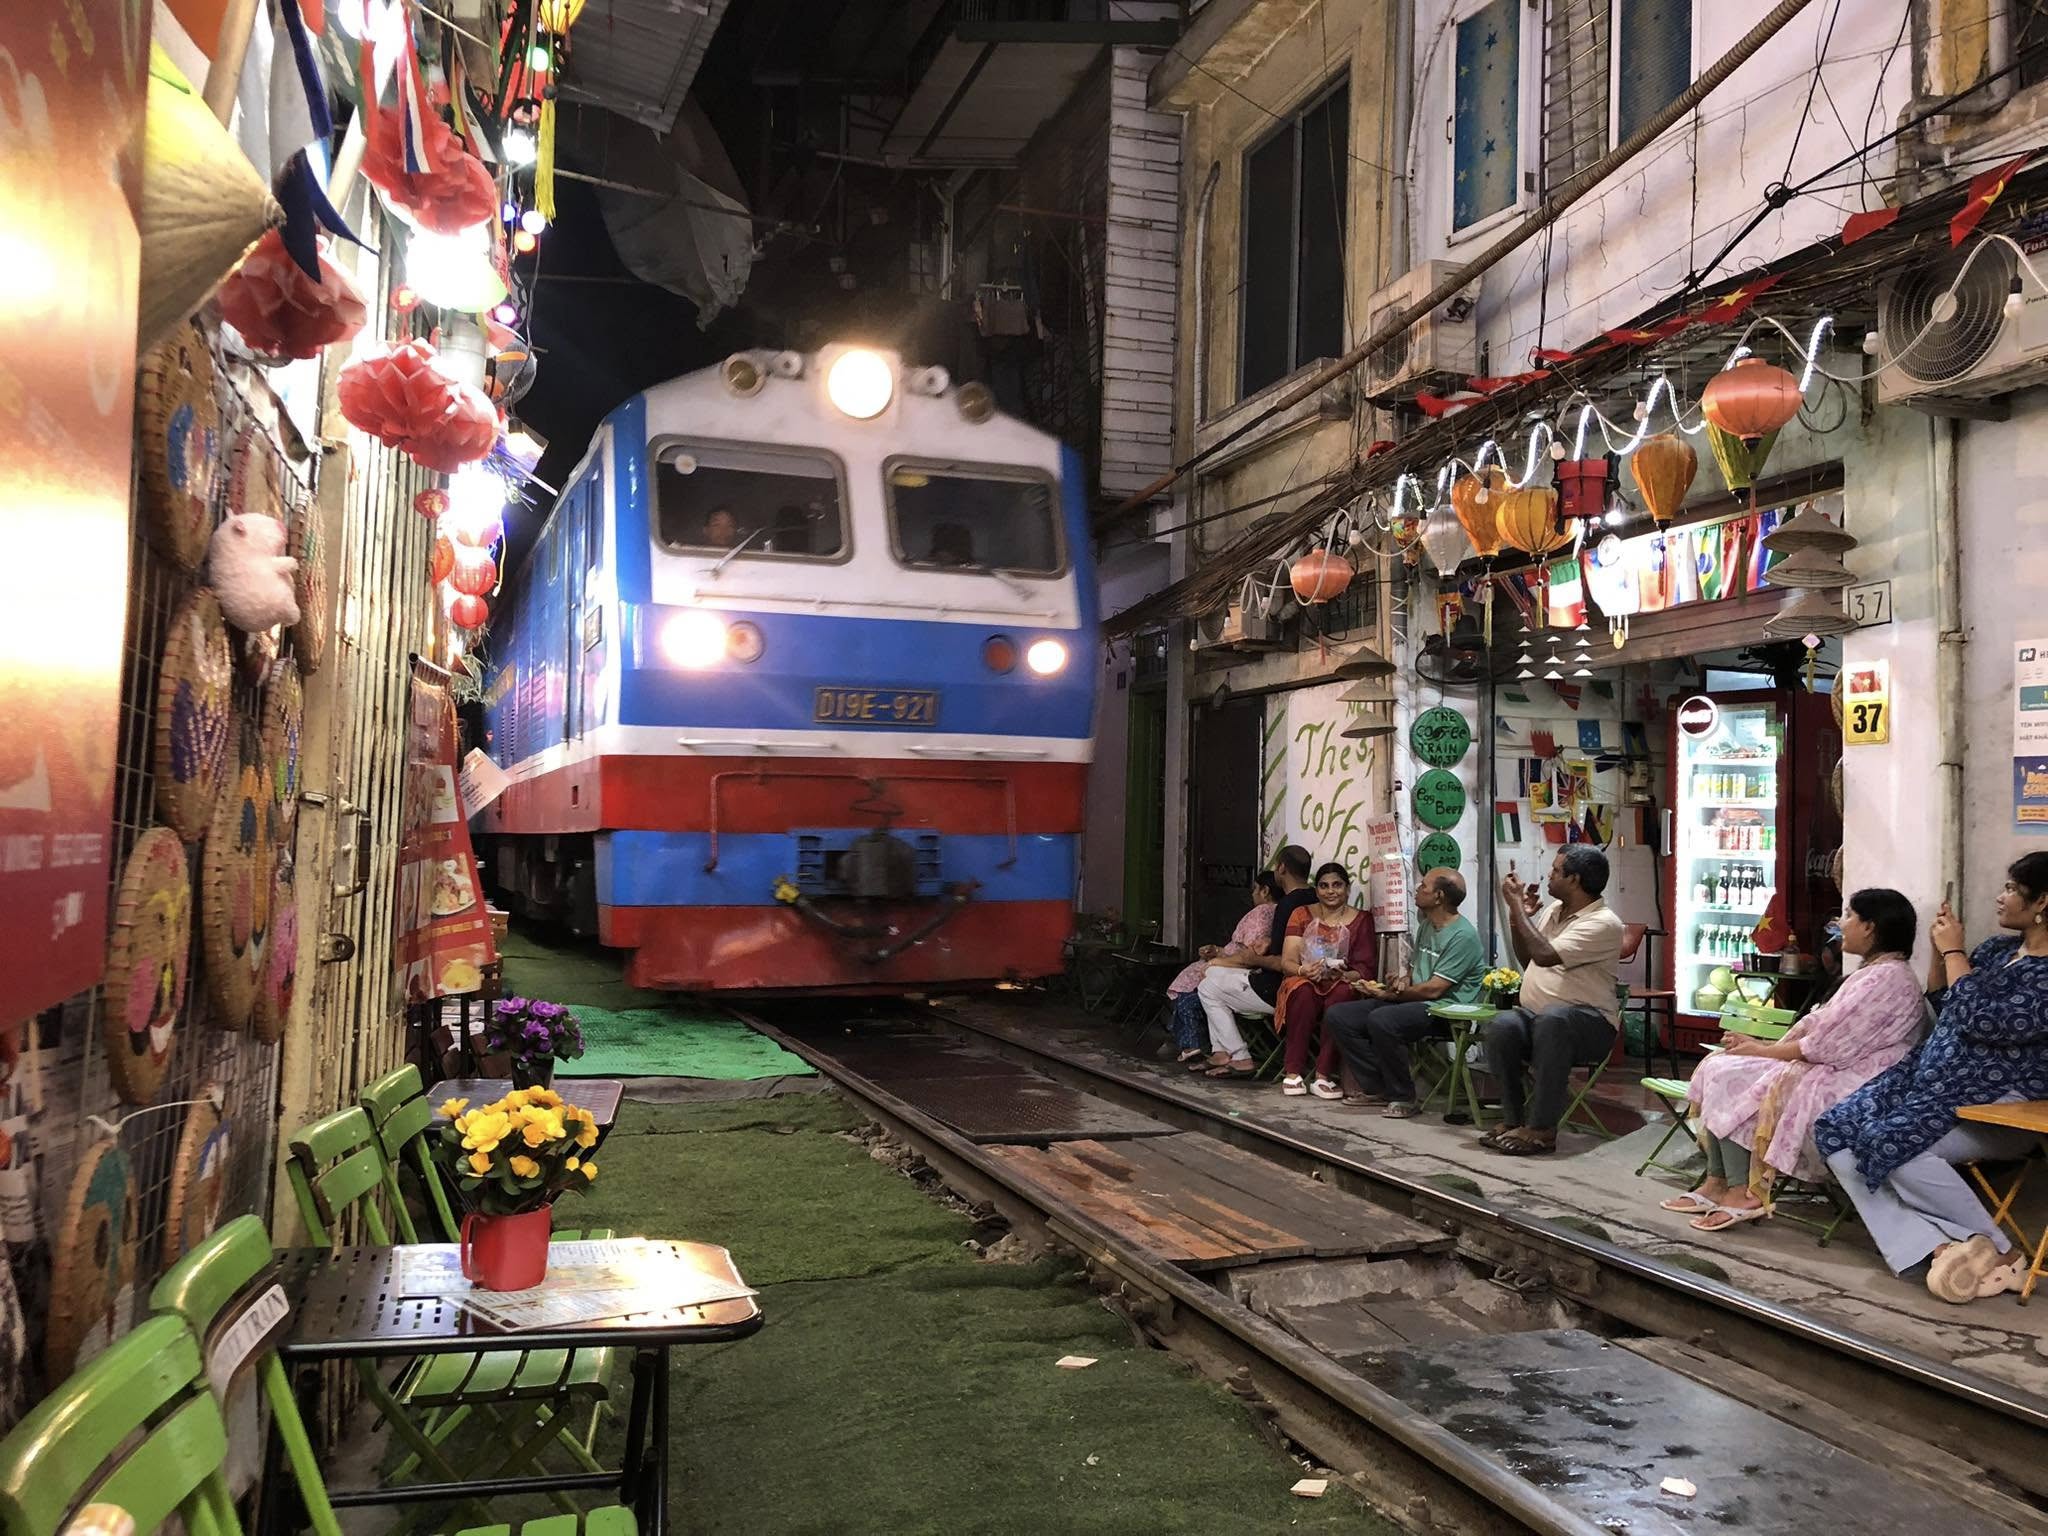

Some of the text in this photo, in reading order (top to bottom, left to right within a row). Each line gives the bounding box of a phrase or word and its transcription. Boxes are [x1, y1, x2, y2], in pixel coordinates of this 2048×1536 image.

[1855, 591, 1884, 621] 37
[816, 692, 936, 722] D19E-921
[1432, 711, 1456, 723] THE
[1853, 703, 1882, 734] 37
[1295, 720, 1351, 778] The
[1418, 741, 1457, 755] TRAIN
